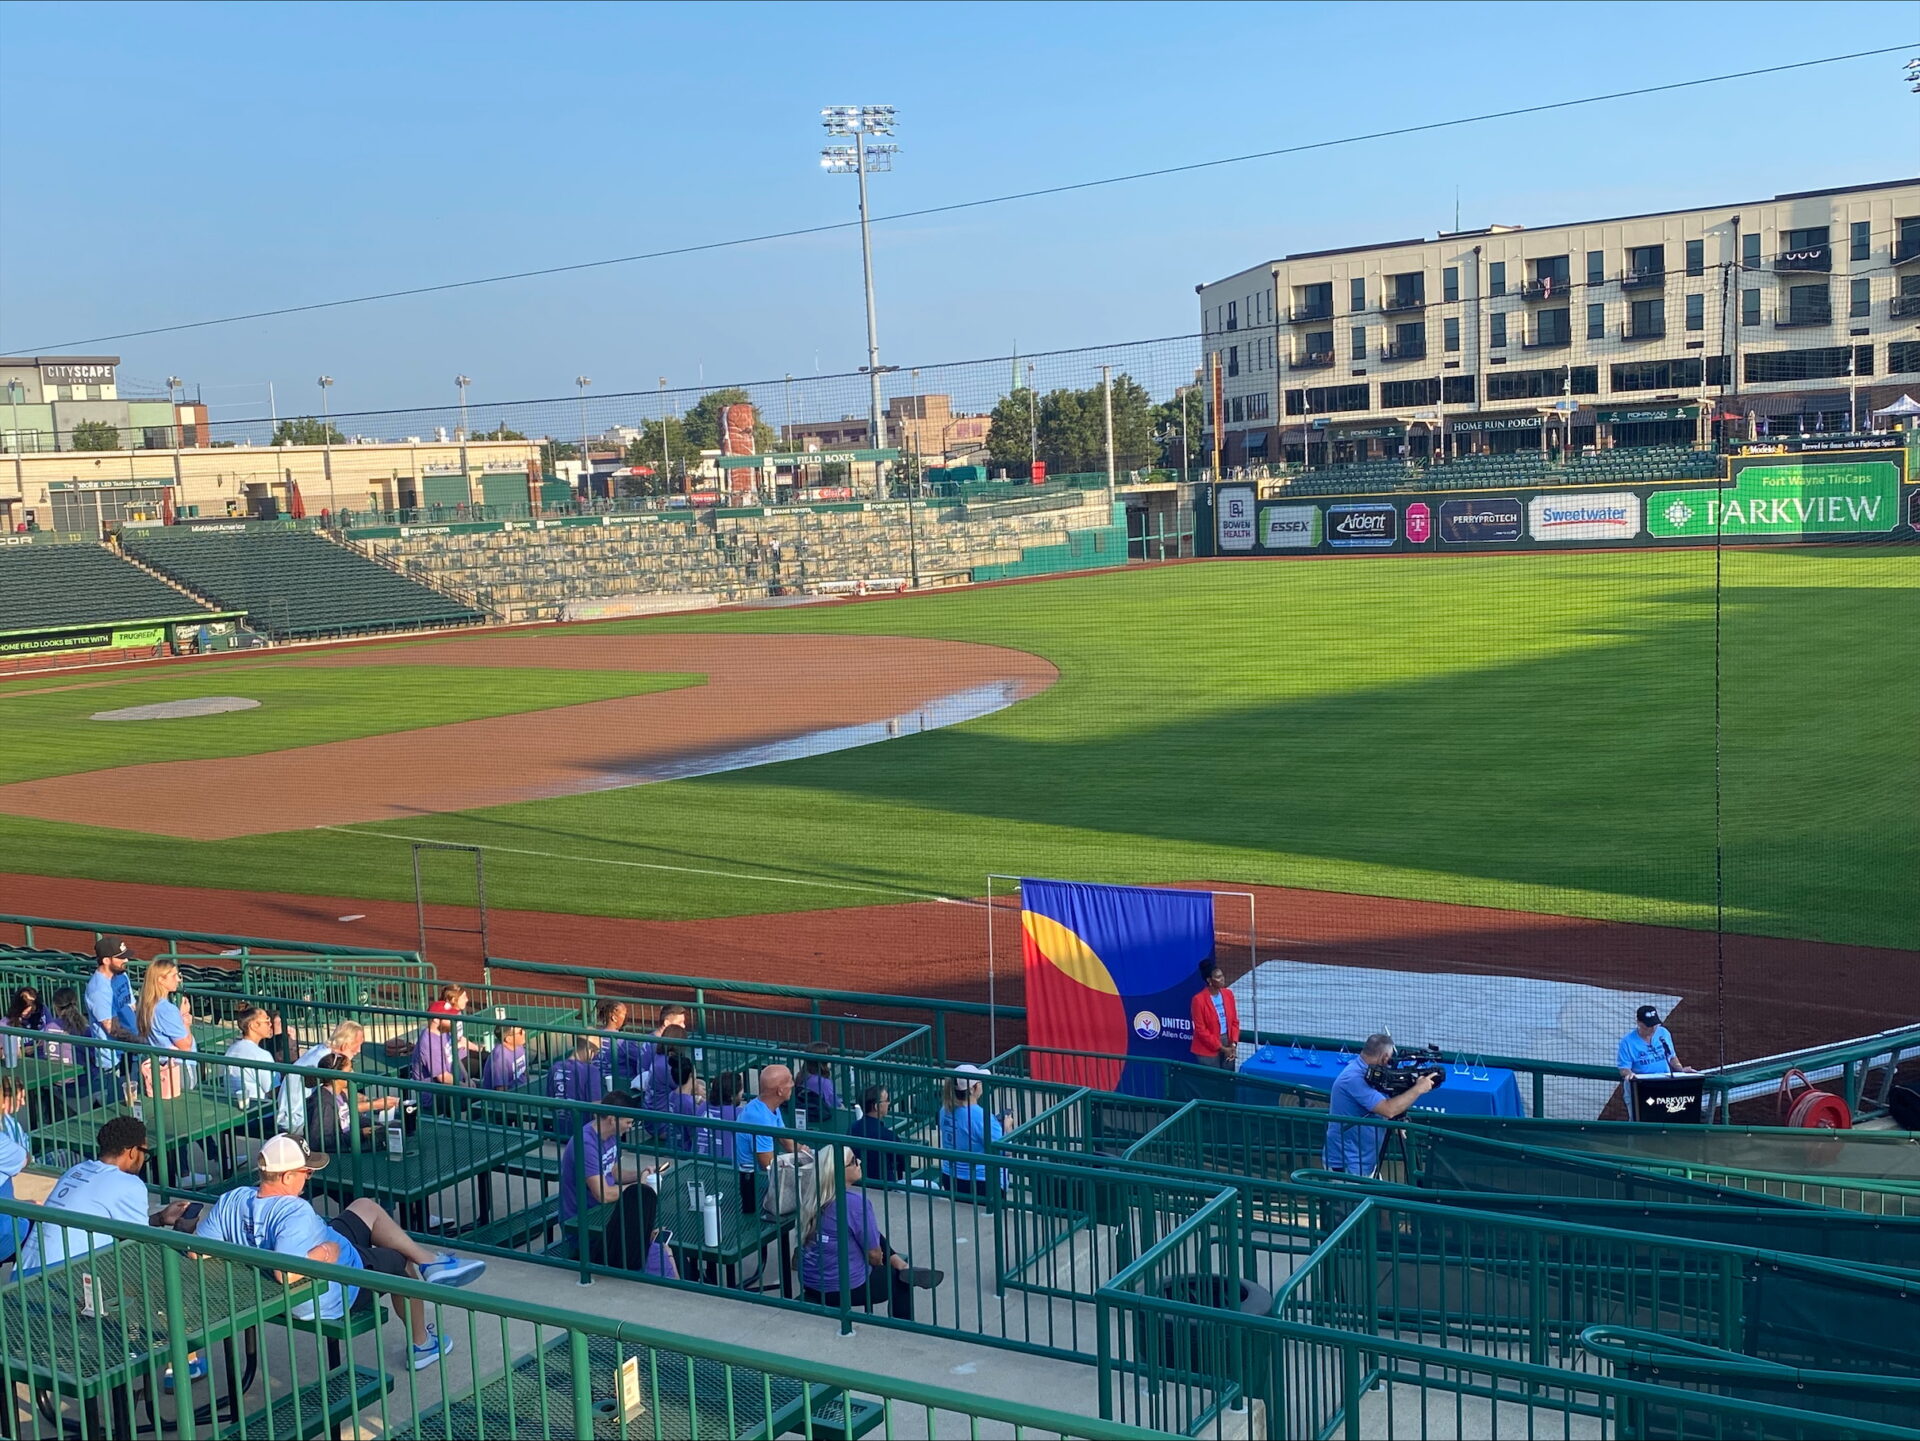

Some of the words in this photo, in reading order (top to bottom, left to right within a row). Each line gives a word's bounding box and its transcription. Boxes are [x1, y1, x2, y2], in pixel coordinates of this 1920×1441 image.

[47, 366, 112, 378] CITYSCAPE
[1453, 421, 1482, 431] HOME
[1485, 421, 1505, 429] RUN
[1507, 417, 1542, 428] PORCH
[797, 454, 822, 464] FIELD
[824, 453, 856, 463] BOXES
[1762, 477, 1786, 487] Fort
[1788, 475, 1825, 487] Wayne
[1827, 473, 1872, 486] TinCaps
[1543, 507, 1627, 522] Sweetwater
[1707, 495, 1882, 526] PARKVIEW
[1222, 520, 1251, 529] BOWEN
[1271, 521, 1310, 532] ESSEX
[1342, 513, 1386, 529] Afdent
[1223, 530, 1251, 538] HEALTH
[119, 631, 156, 641] TRUGREEN
[20, 640, 40, 650] FIELD
[40, 638, 64, 647] LOOKS
[64, 636, 90, 646] BETTER
[90, 635, 109, 644] WITH
[1161, 1017, 1191, 1031] UNITED
[1161, 1031, 1178, 1039] Allen
[1656, 1095, 1695, 1105] PARKVIEW
